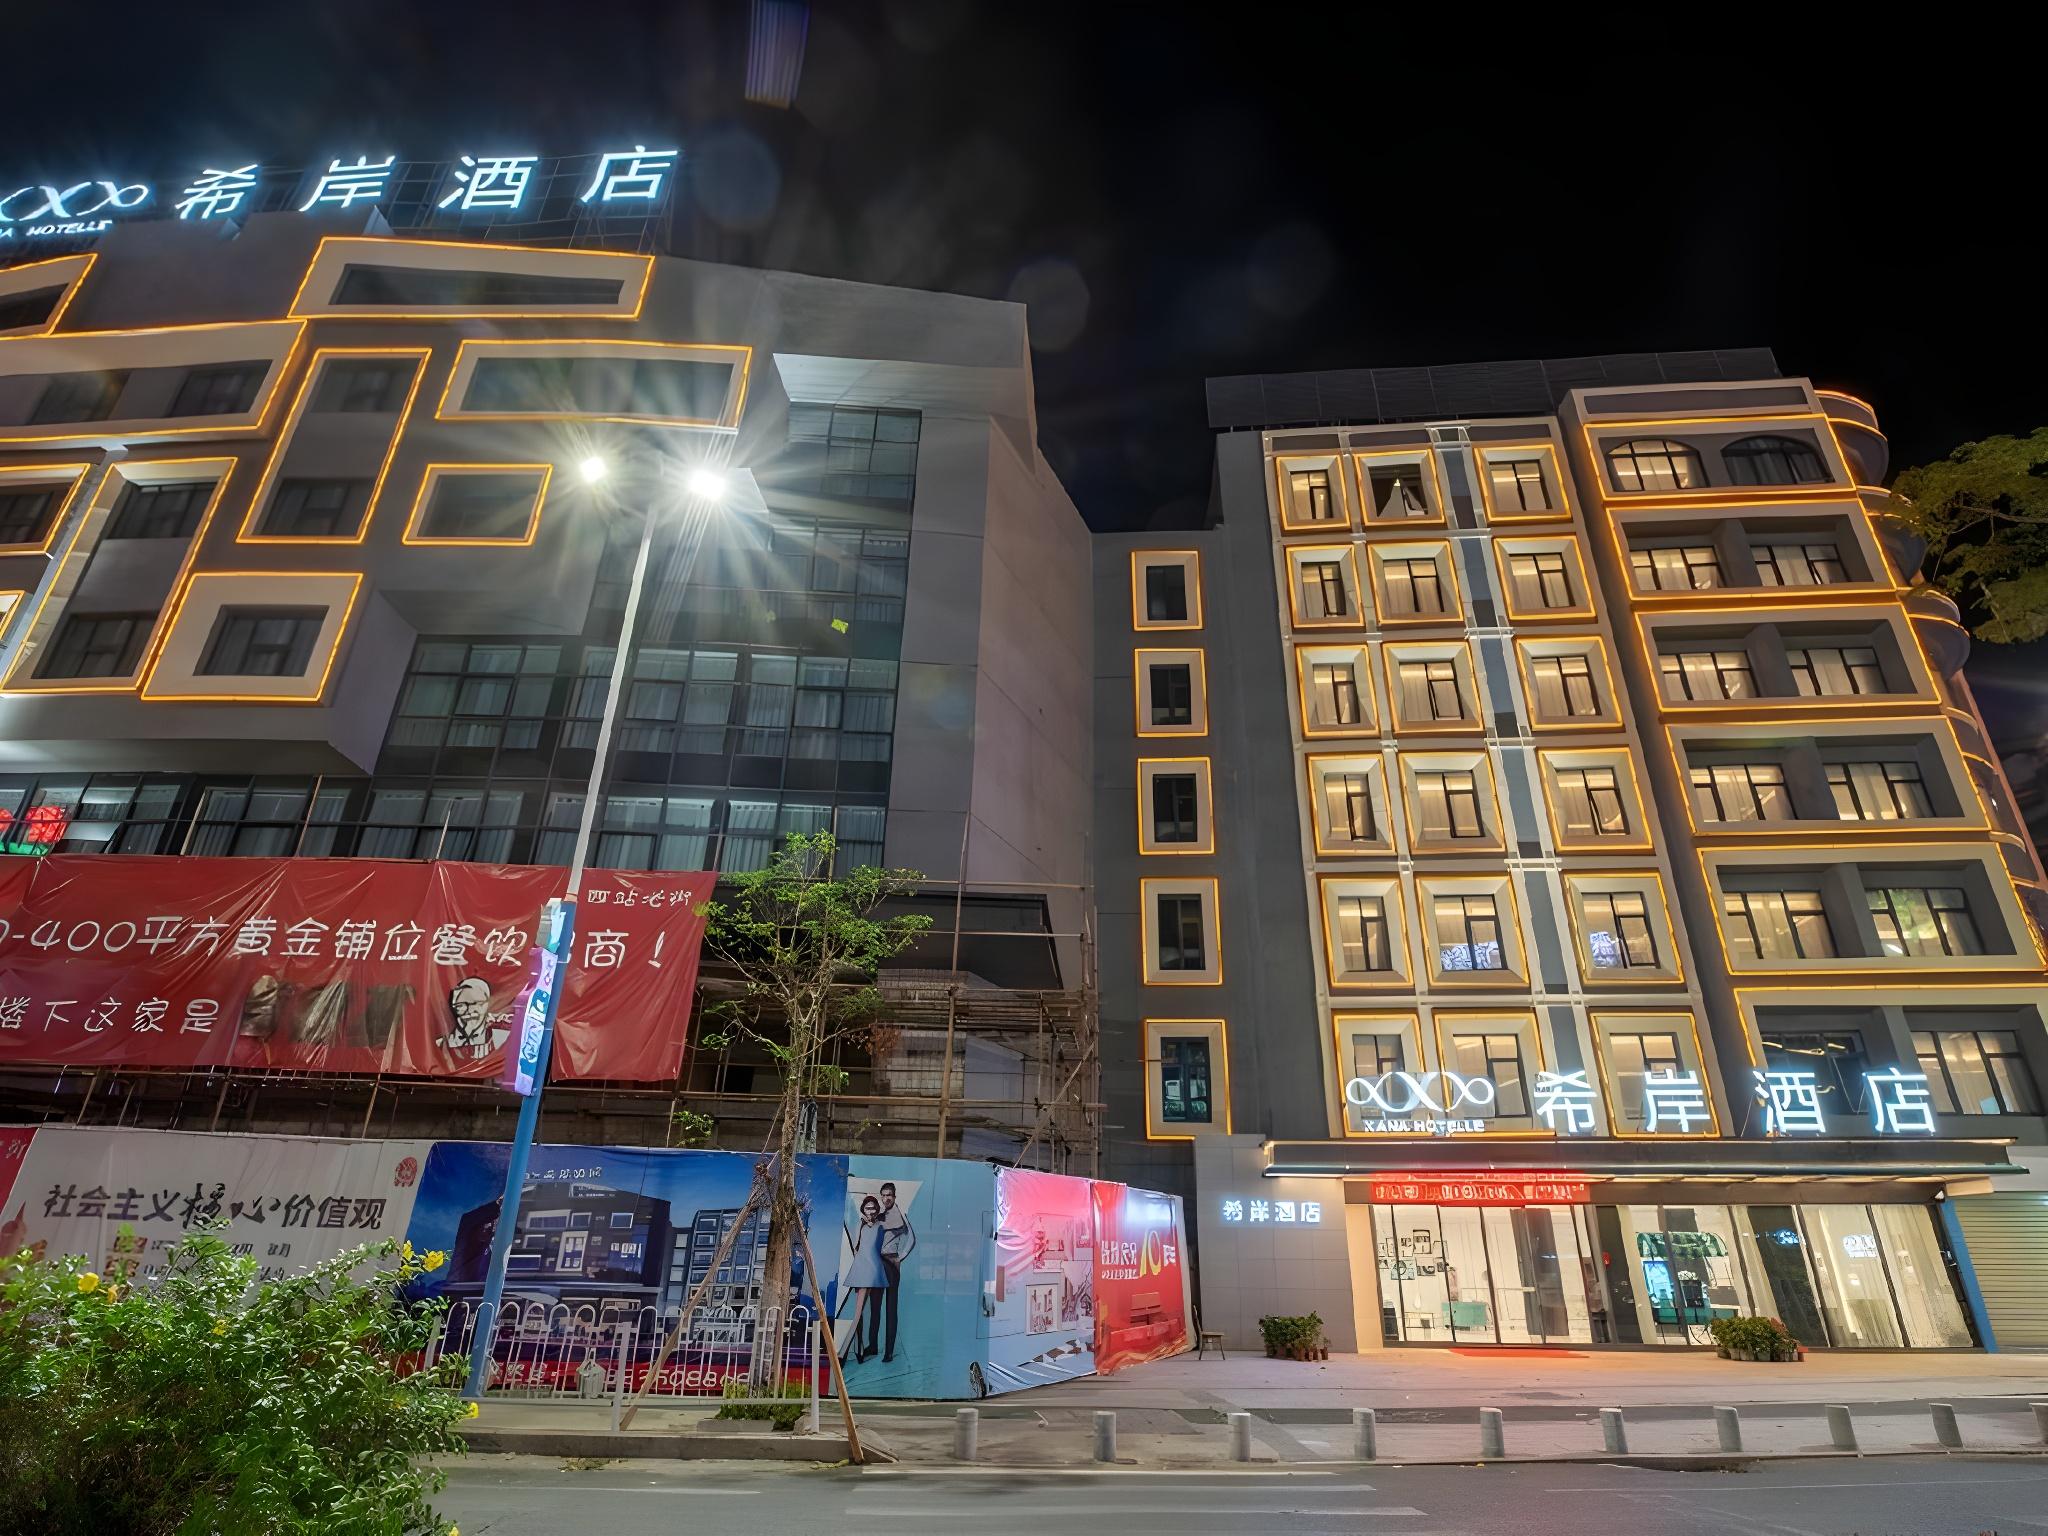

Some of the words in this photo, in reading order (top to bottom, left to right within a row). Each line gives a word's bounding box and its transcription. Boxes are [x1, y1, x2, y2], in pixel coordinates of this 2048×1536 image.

[174, 145, 678, 220] 希岸酒店
[1534, 1068, 1937, 1134] 希岸酒店
[44, 1183, 387, 1231] 社会主义核心价值观
